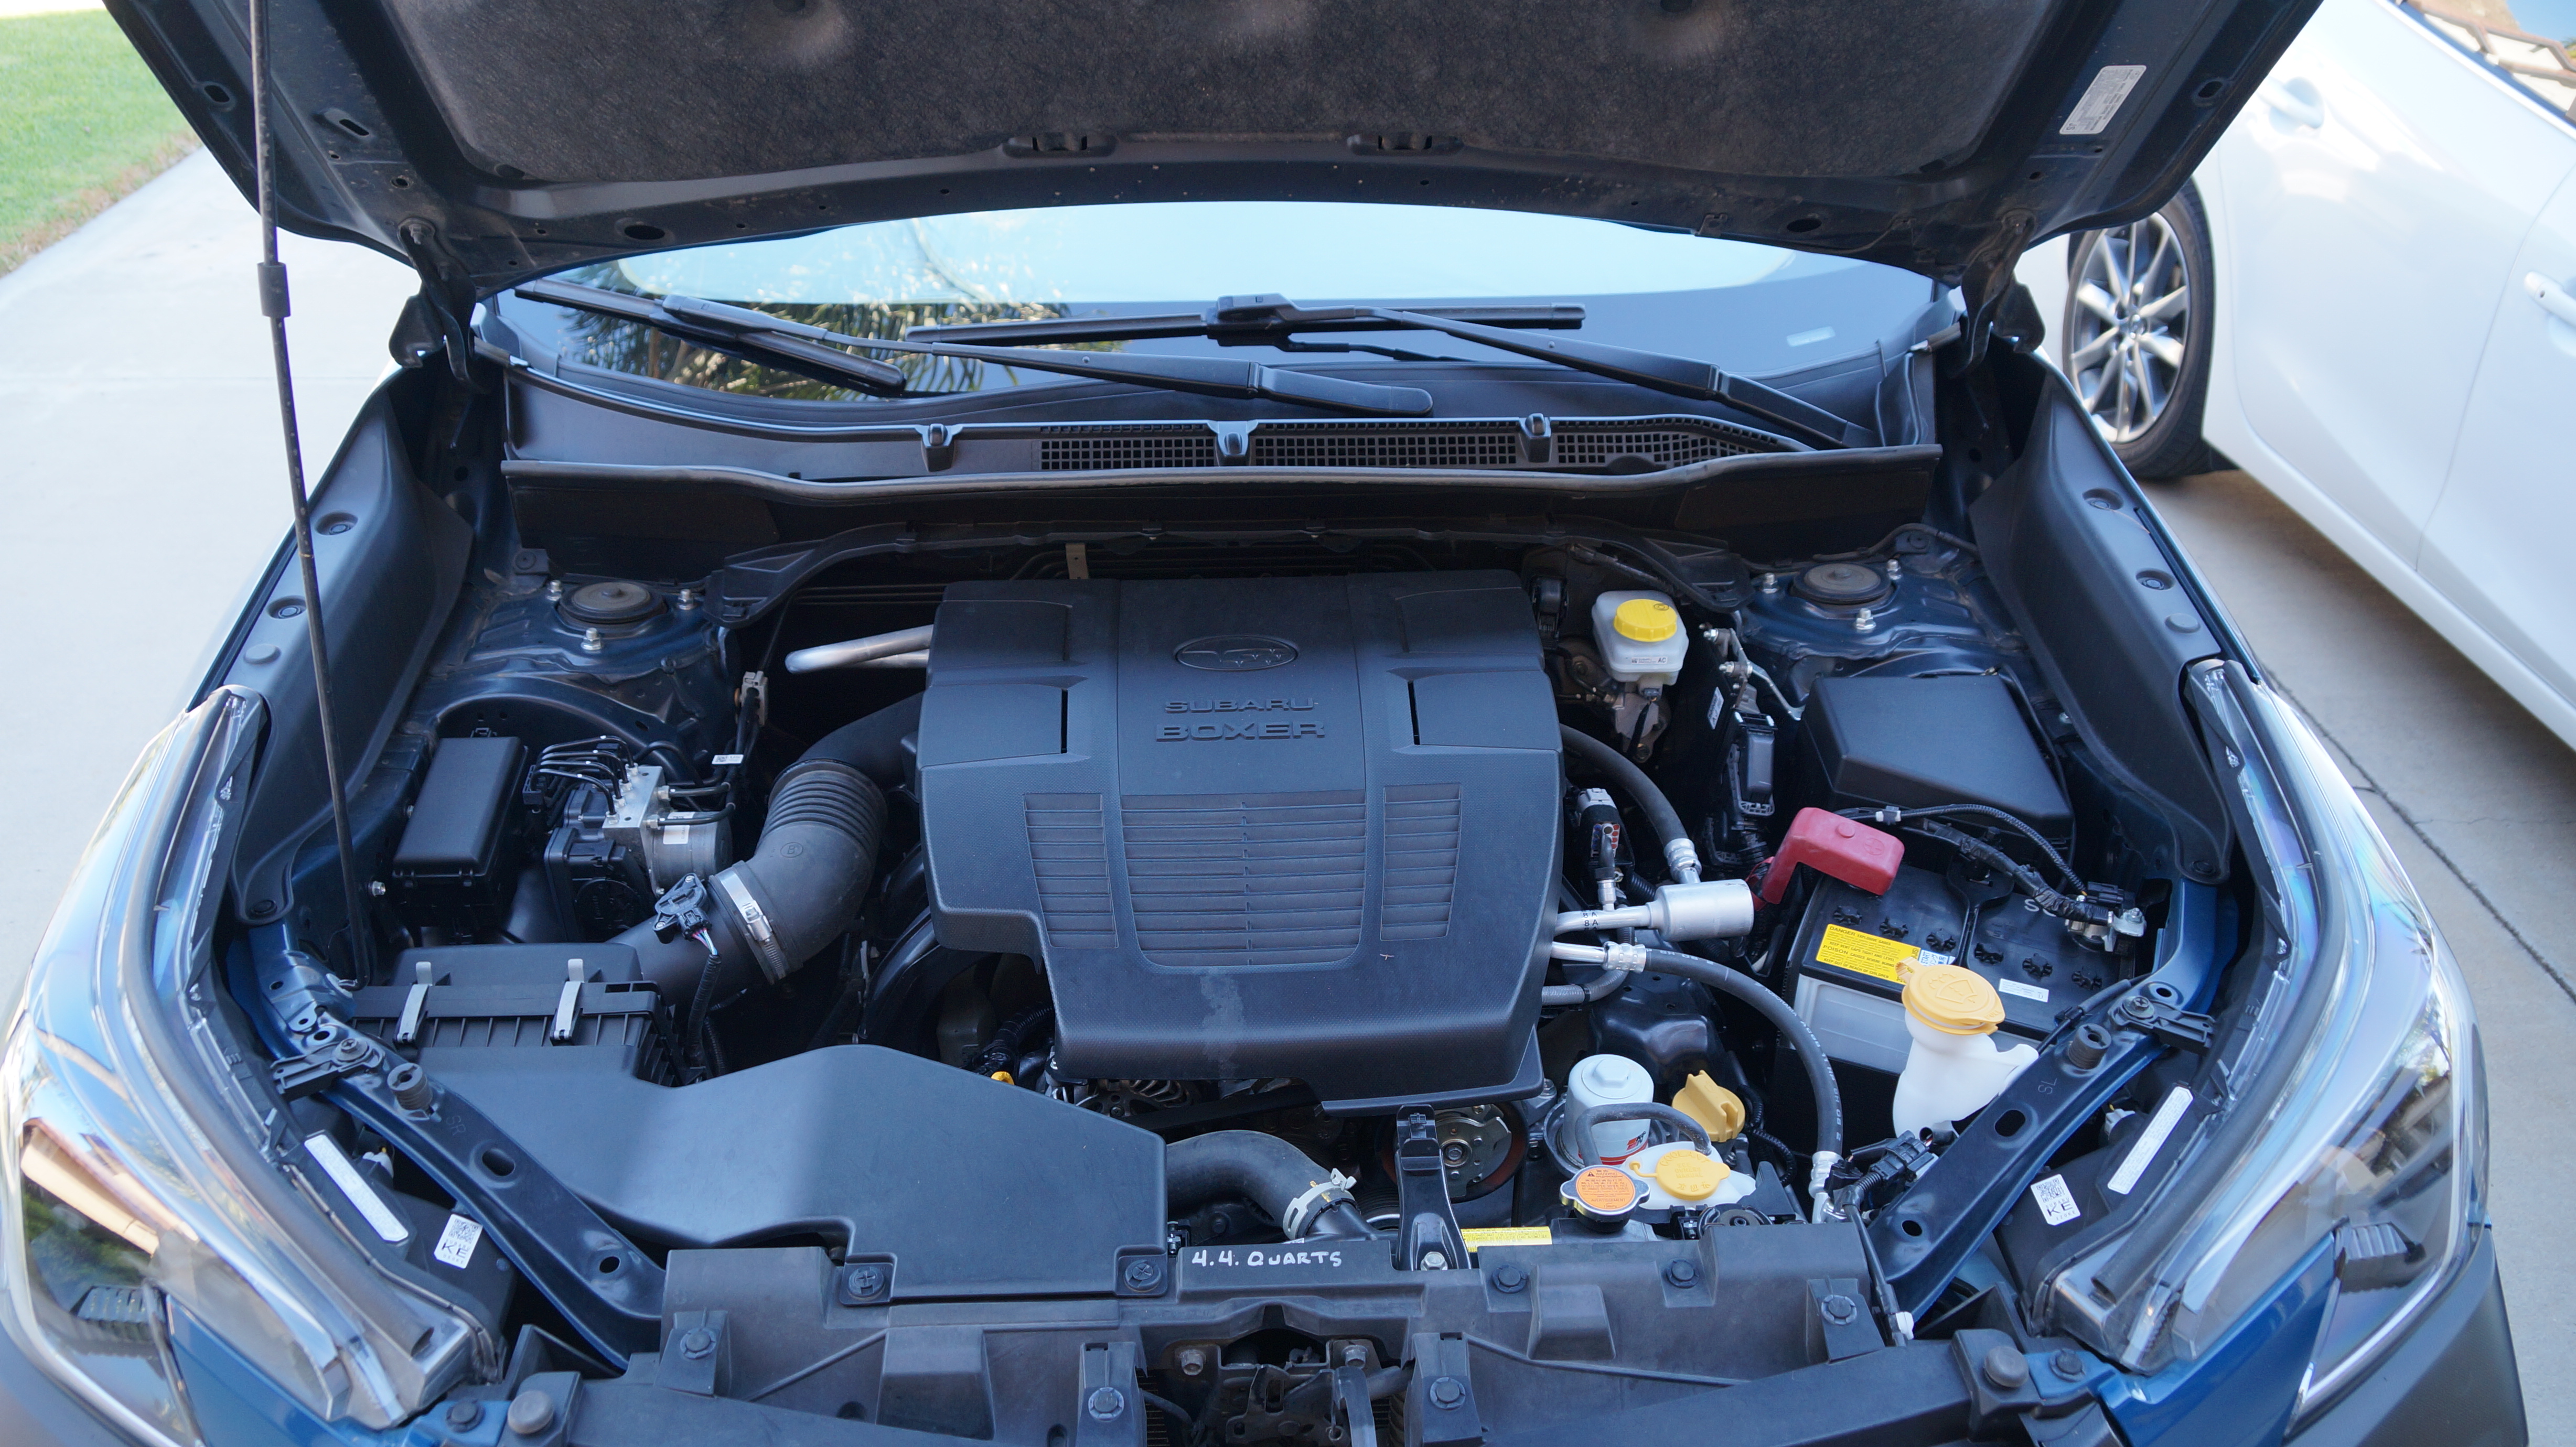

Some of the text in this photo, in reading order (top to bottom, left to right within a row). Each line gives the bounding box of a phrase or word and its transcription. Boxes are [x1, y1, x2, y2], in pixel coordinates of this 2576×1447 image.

[1165, 698, 1314, 714] SUBARU
[1156, 721, 1325, 742] BOXER
[1829, 926, 1855, 936] DANGER
[1823, 945, 1849, 955] POISON
[2037, 1078, 2057, 1095] SL
[446, 1115, 466, 1136] SR
[1660, 1151, 1711, 1167] COOLANT
[2047, 1201, 2074, 1217] KE
[442, 1241, 469, 1259] KE
[1247, 1251, 1342, 1267] QUARTS
